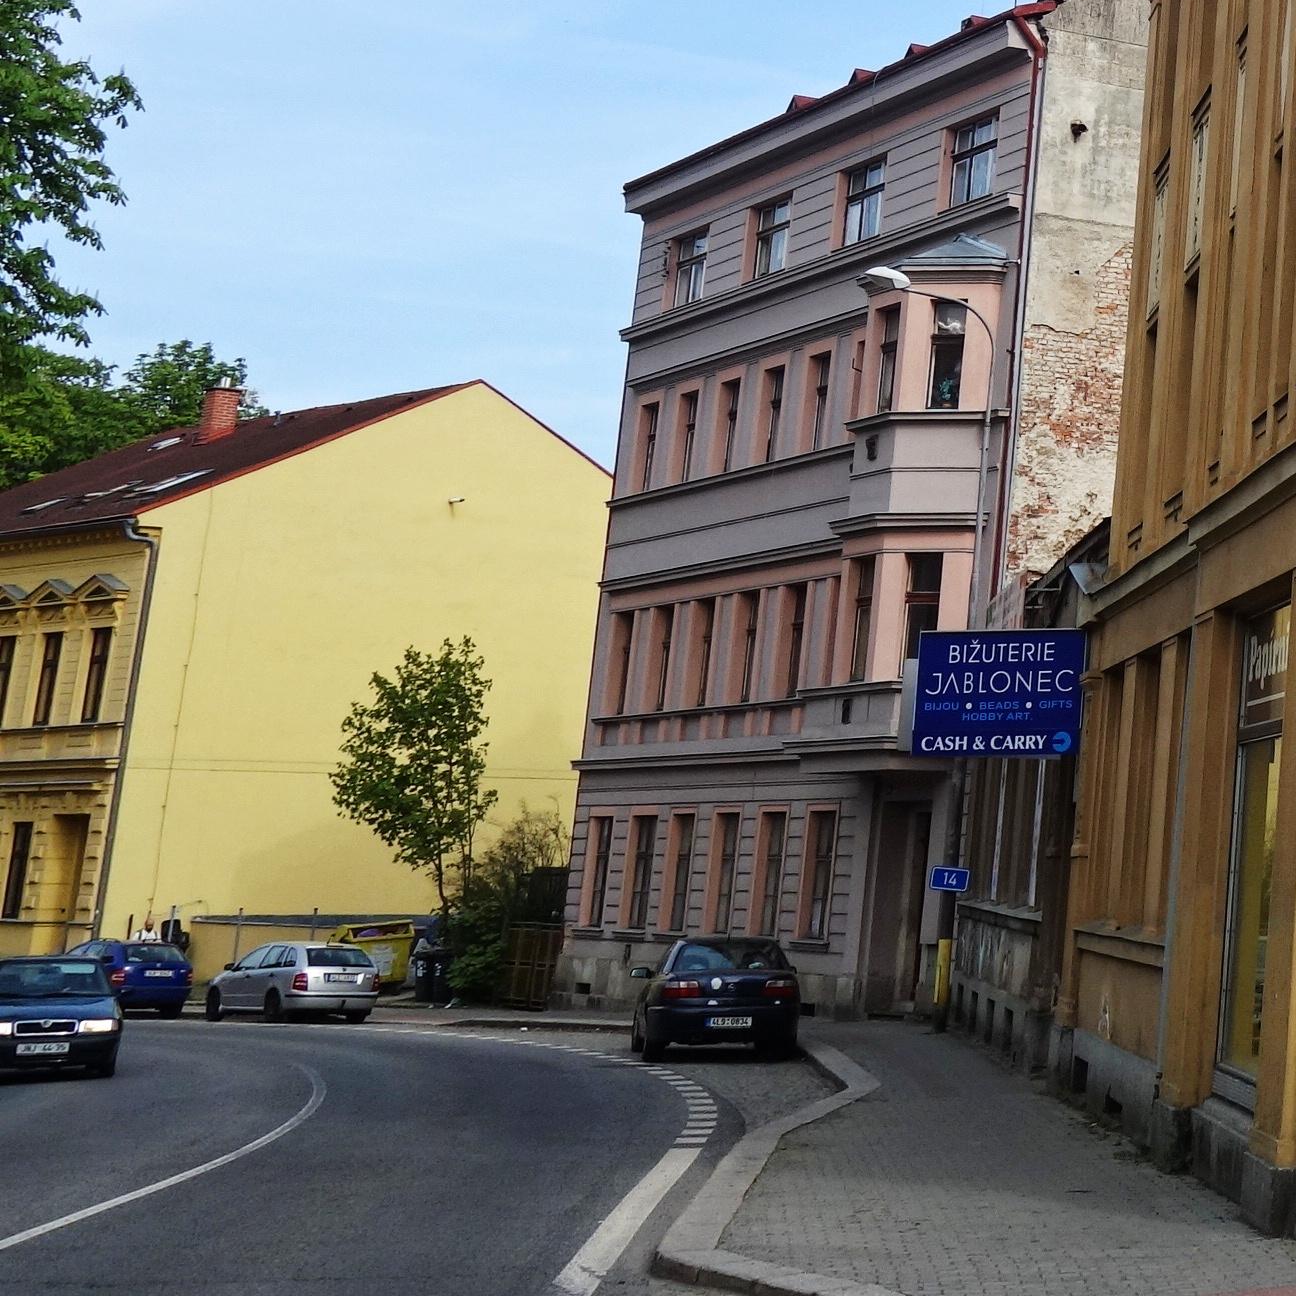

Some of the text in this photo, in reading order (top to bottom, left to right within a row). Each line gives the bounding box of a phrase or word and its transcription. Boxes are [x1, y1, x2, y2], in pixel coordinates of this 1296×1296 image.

[948, 639, 1056, 664] BIŽUTERIE
[925, 669, 1075, 695] JABLONEC
[924, 699, 1074, 712] BIJOU BEADS GIFTS
[961, 712, 1002, 722] HOBBY
[921, 734, 1048, 751] CASH & CARRY
[943, 871, 957, 886] 14
